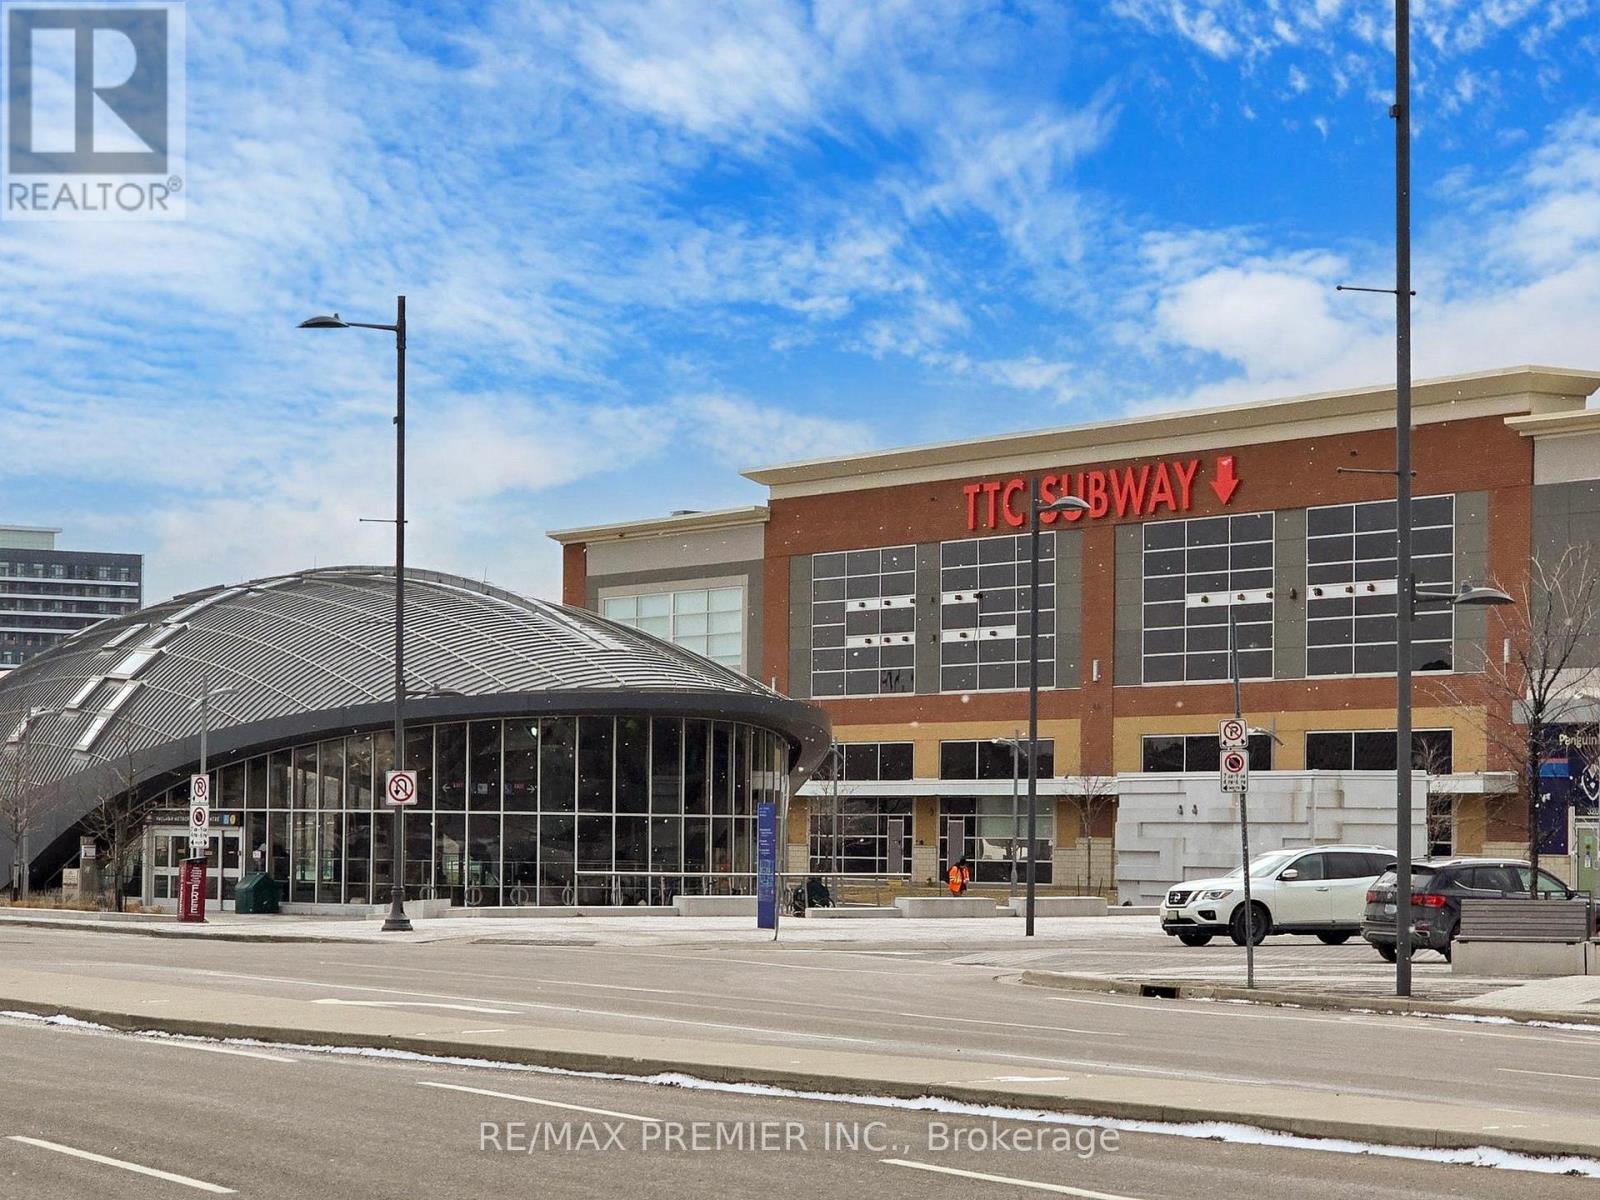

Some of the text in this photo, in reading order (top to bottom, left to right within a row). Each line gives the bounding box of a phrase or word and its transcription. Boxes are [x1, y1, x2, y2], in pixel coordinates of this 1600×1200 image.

[963, 459, 1199, 530] TTC SUBWAY
[1559, 734, 1597, 748] Penguin
